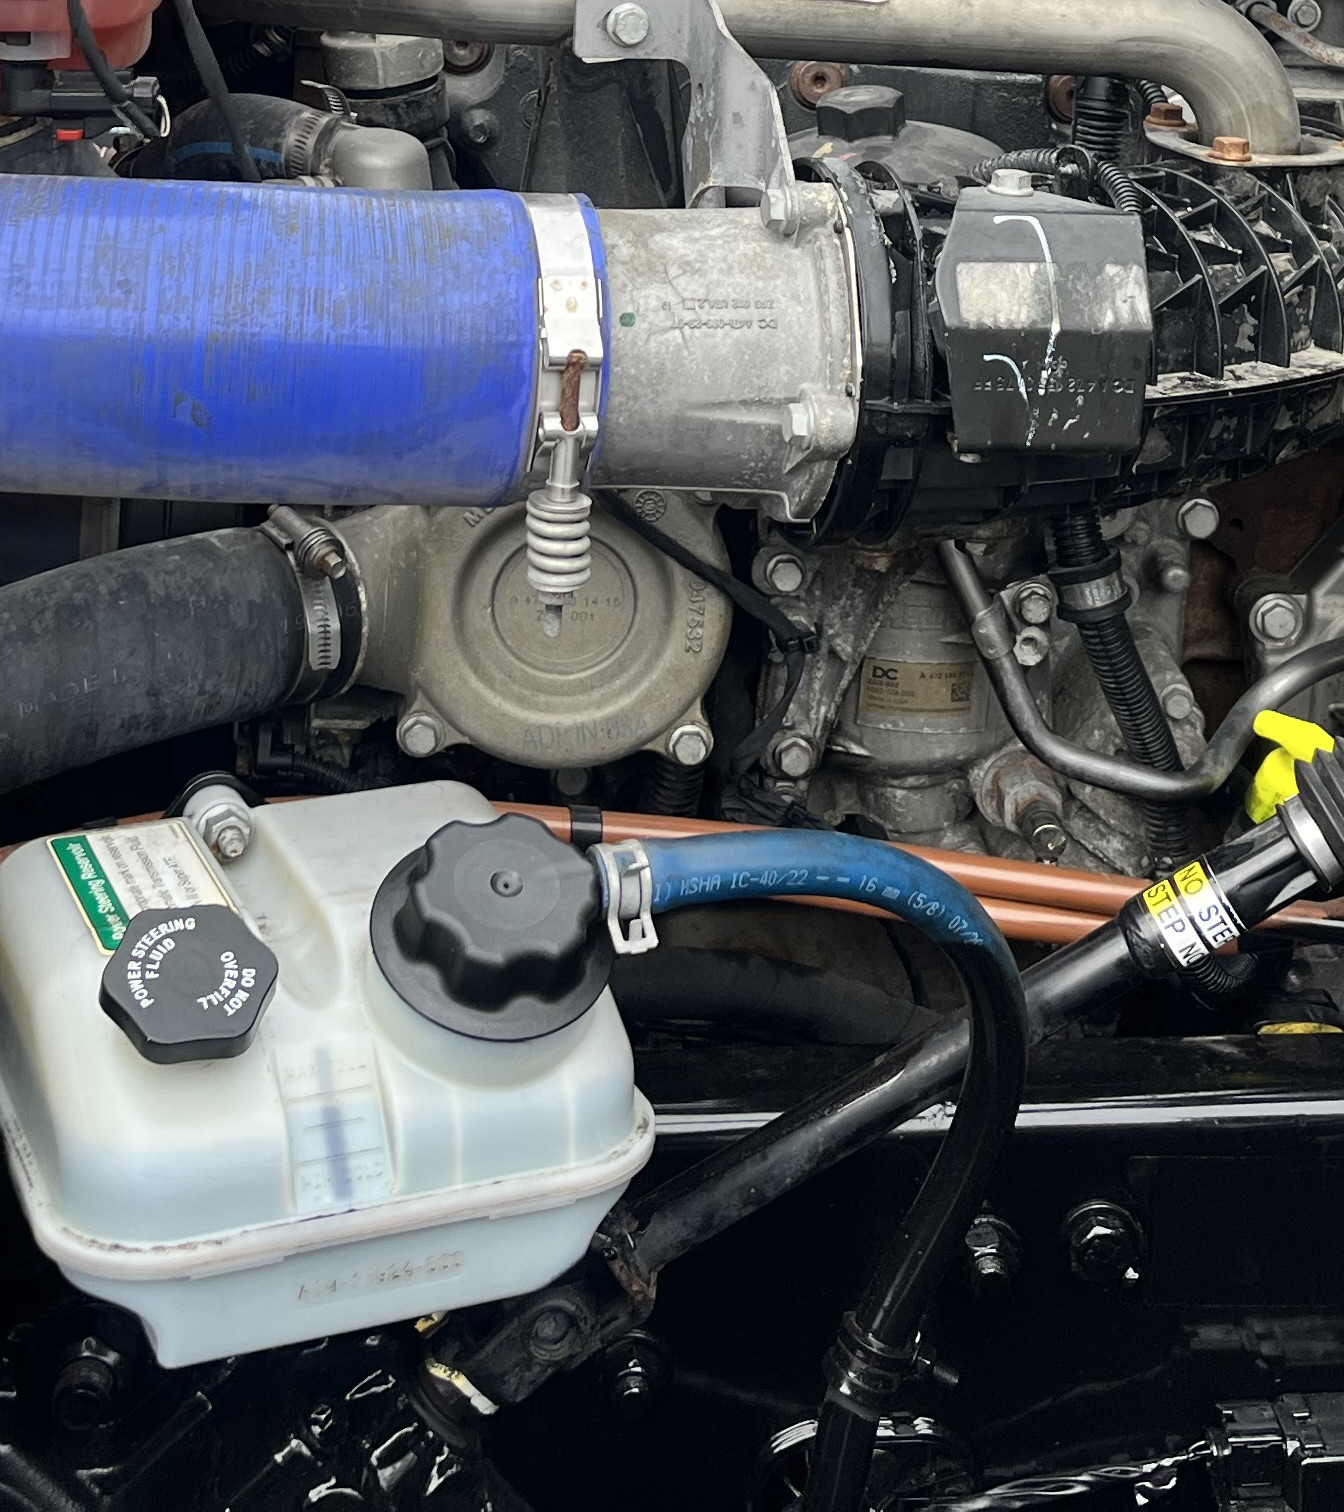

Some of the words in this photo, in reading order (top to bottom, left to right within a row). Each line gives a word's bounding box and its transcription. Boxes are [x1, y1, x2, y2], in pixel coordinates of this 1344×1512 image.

[871, 665, 899, 681] DC
[65, 842, 98, 880] Reservoir
[1179, 865, 1205, 896] NO
[88, 879, 116, 914] Steering
[730, 868, 809, 890] IC-40/22
[907, 890, 946, 919] (5/8)
[1147, 883, 1186, 933] STEP
[131, 917, 196, 959] STEERING
[145, 937, 176, 980] FLUID
[241, 968, 256, 988] DO
[127, 960, 155, 1009] POWER
[196, 951, 239, 1010] OVERFILL
[223, 989, 250, 1017] NOT
